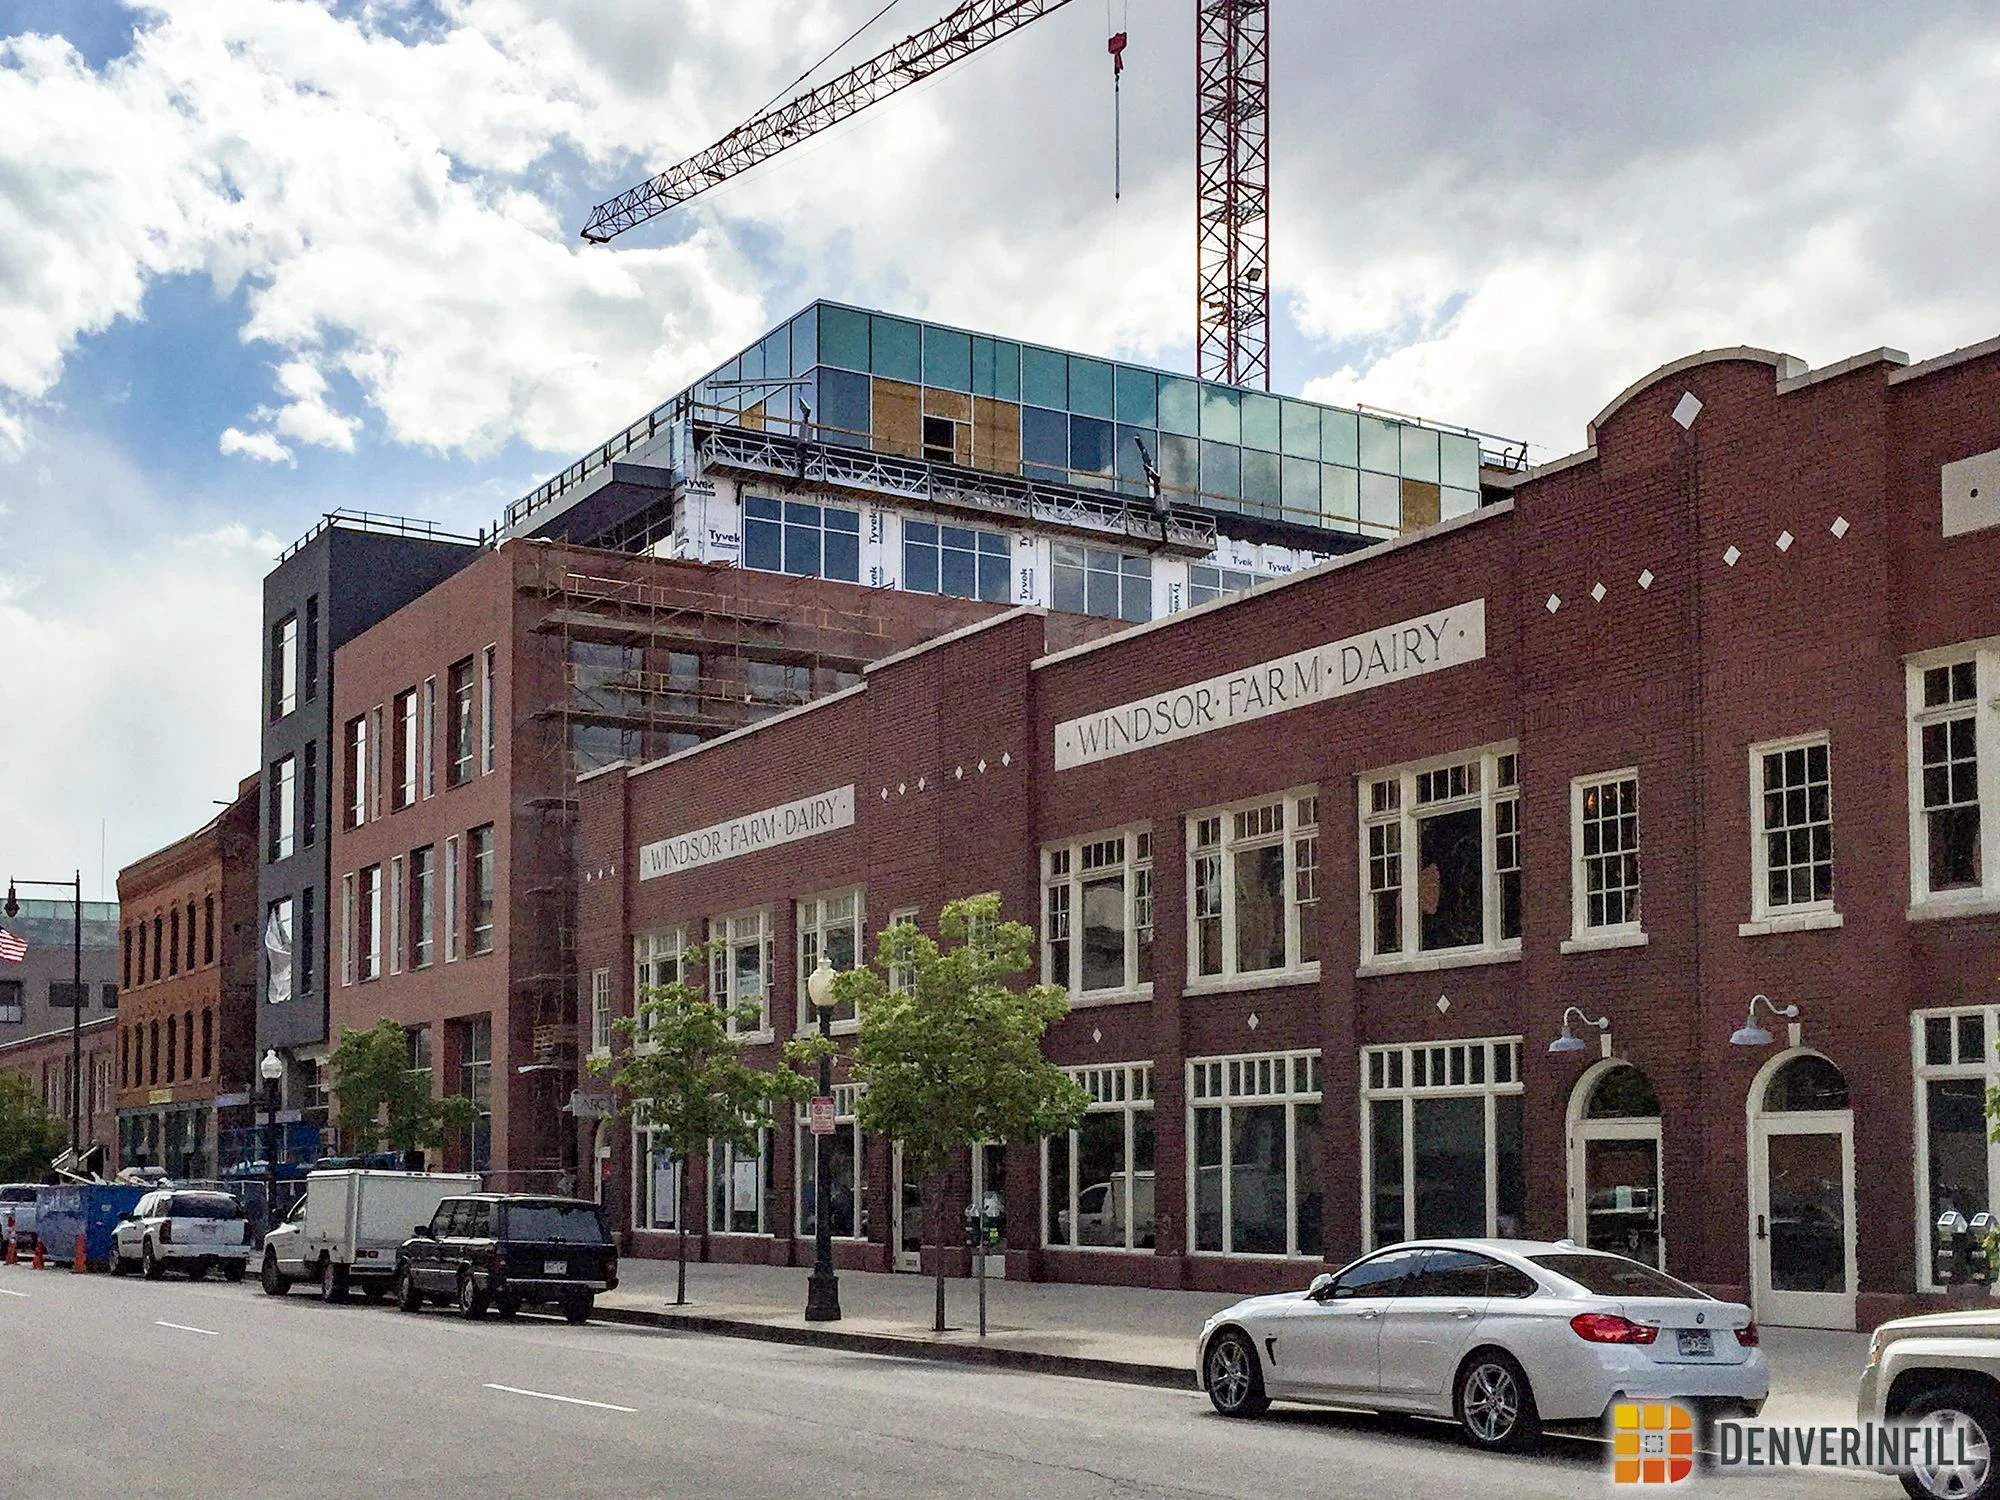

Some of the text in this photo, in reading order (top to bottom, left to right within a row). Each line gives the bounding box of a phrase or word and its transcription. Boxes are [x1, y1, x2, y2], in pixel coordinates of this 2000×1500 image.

[684, 477, 715, 489] Tyvek
[709, 529, 741, 543] Tyvek
[869, 510, 879, 545] Tyvek
[869, 566, 878, 587] vek
[1267, 561, 1293, 573] Tyvek
[1020, 568, 1029, 600] Tyvek
[1174, 582, 1182, 614] Tyvek
[1077, 617, 1450, 756] WINDSOR FARM DAIRY
[650, 796, 838, 872] WINDSOR FARM DAIRY
